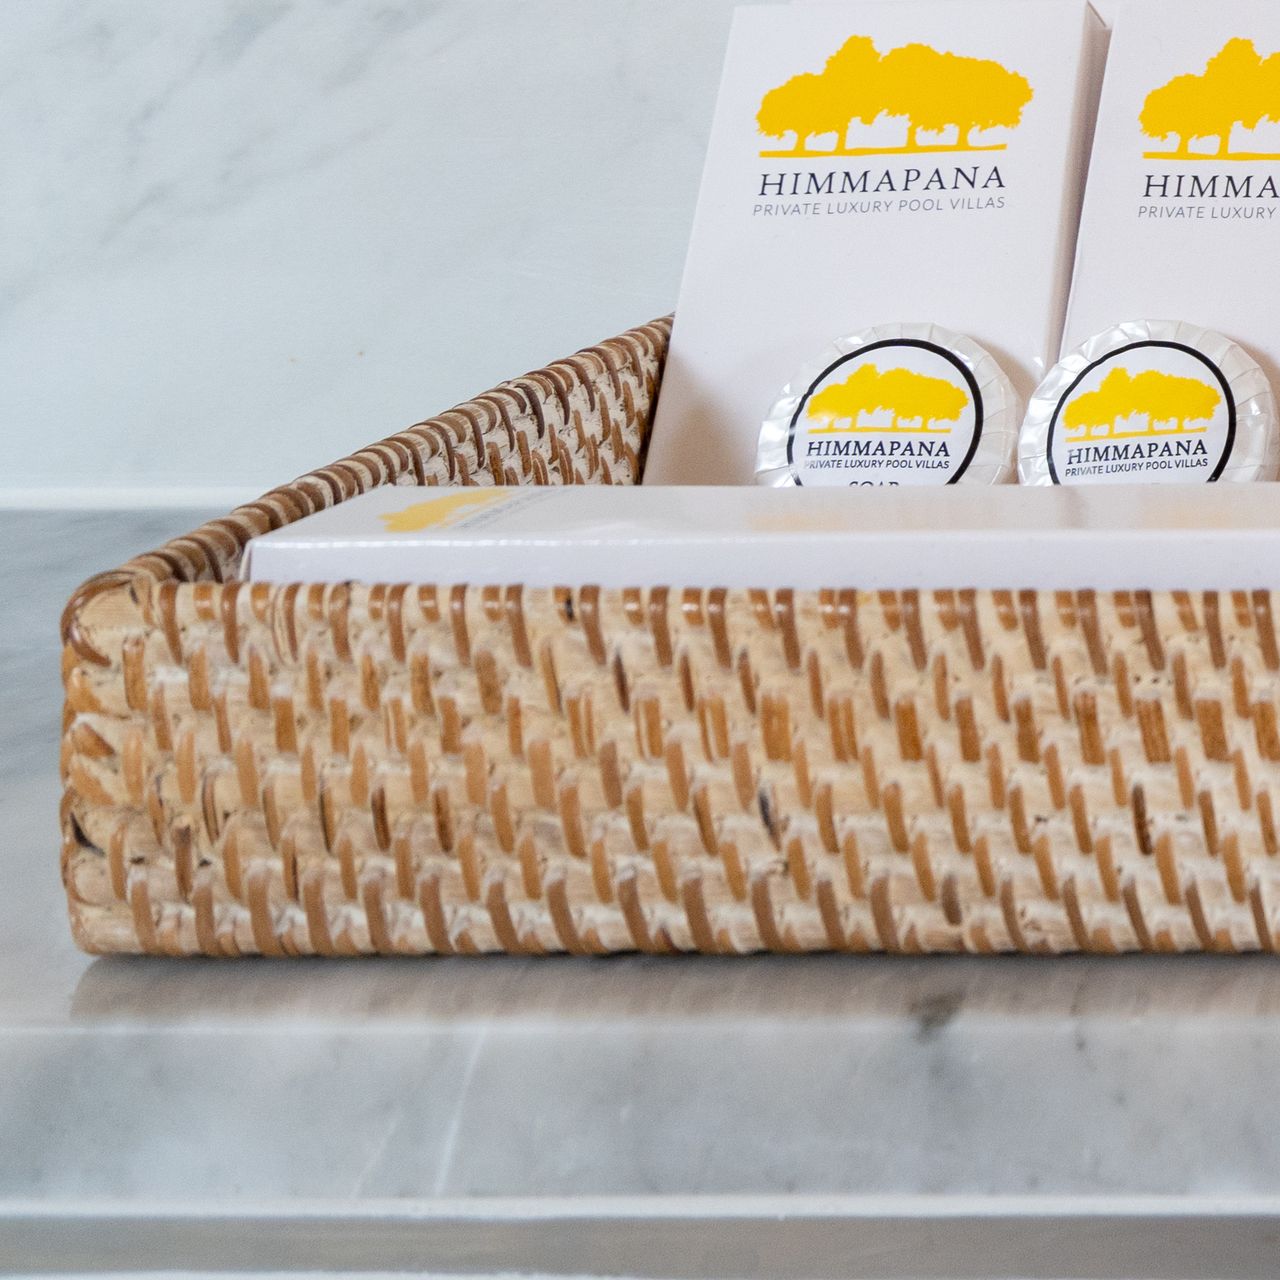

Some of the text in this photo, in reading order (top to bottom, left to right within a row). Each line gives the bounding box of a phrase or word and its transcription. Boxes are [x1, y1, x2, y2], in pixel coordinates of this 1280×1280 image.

[757, 165, 1007, 197] HIMMAPANA
[751, 196, 1006, 217] PRIVATE LUXURY POOL VILLAS
[1137, 205, 1207, 219] PRIVATE
[1210, 206, 1278, 220] LUXURY
[806, 440, 950, 457] HIMMAPANA
[1067, 439, 1208, 465] HIMMAPANA
[804, 459, 950, 470] PRIVATE LUXURY POOL VILLAS
[1065, 458, 1208, 477] PRIVATE LUXURY POOL VILLAS
